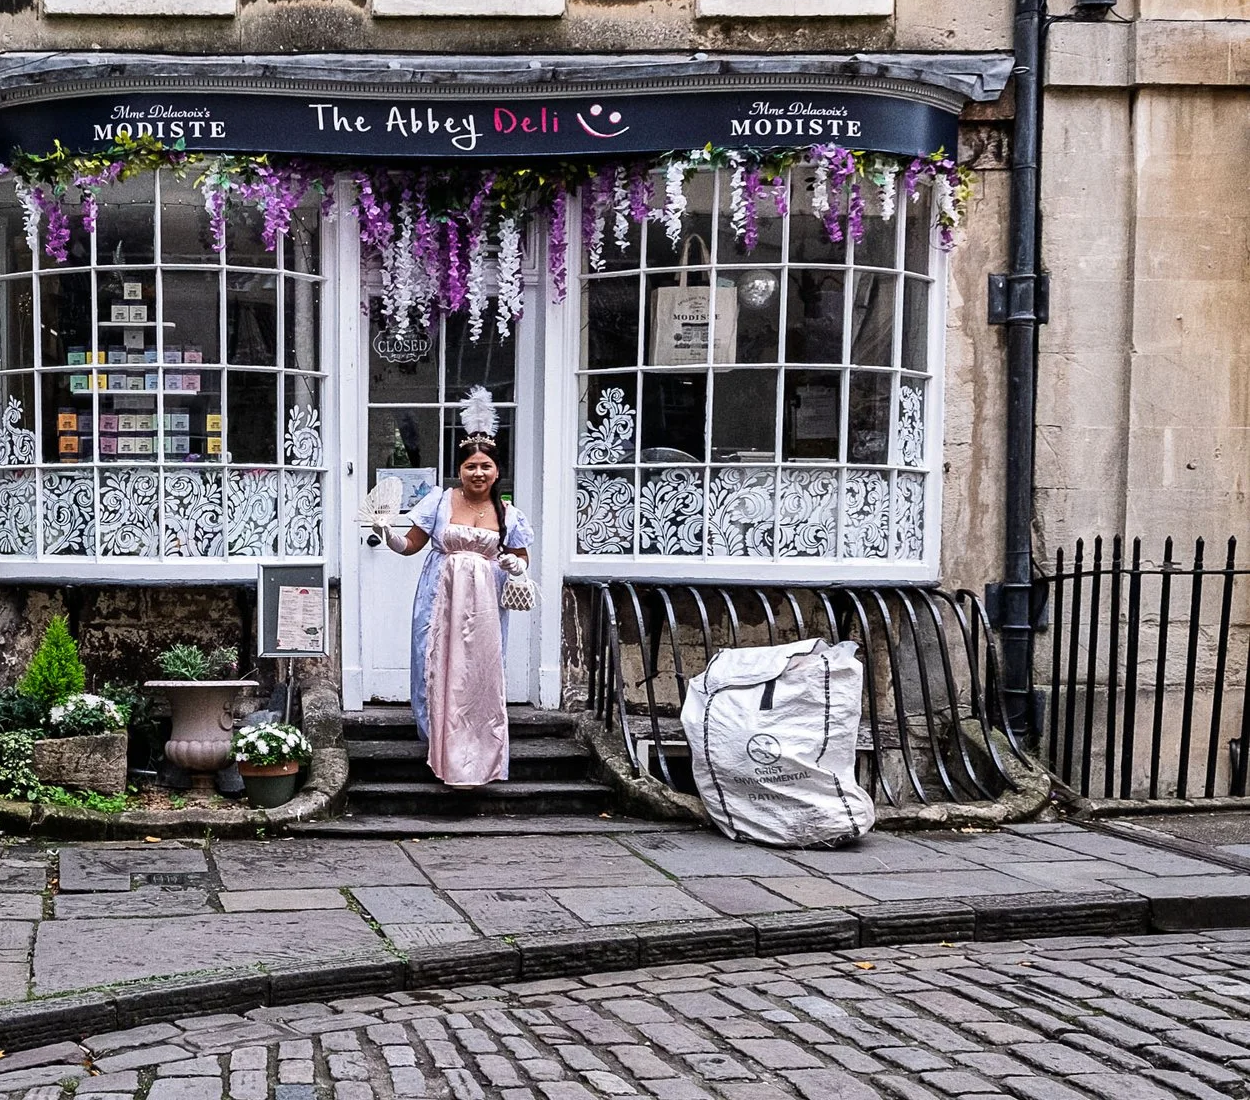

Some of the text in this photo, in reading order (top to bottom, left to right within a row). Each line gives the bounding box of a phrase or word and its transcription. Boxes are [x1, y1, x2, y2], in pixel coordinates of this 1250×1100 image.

[110, 104, 211, 120] Mme Delacroix's
[748, 101, 849, 117] Mme Delacroix's
[93, 120, 227, 141] MODISTE
[308, 103, 559, 150] The Abbey Deli
[730, 118, 863, 138] MODISTE
[673, 313, 721, 321] MODISE
[378, 339, 428, 353] CLOSED
[754, 765, 783, 775] GRIST
